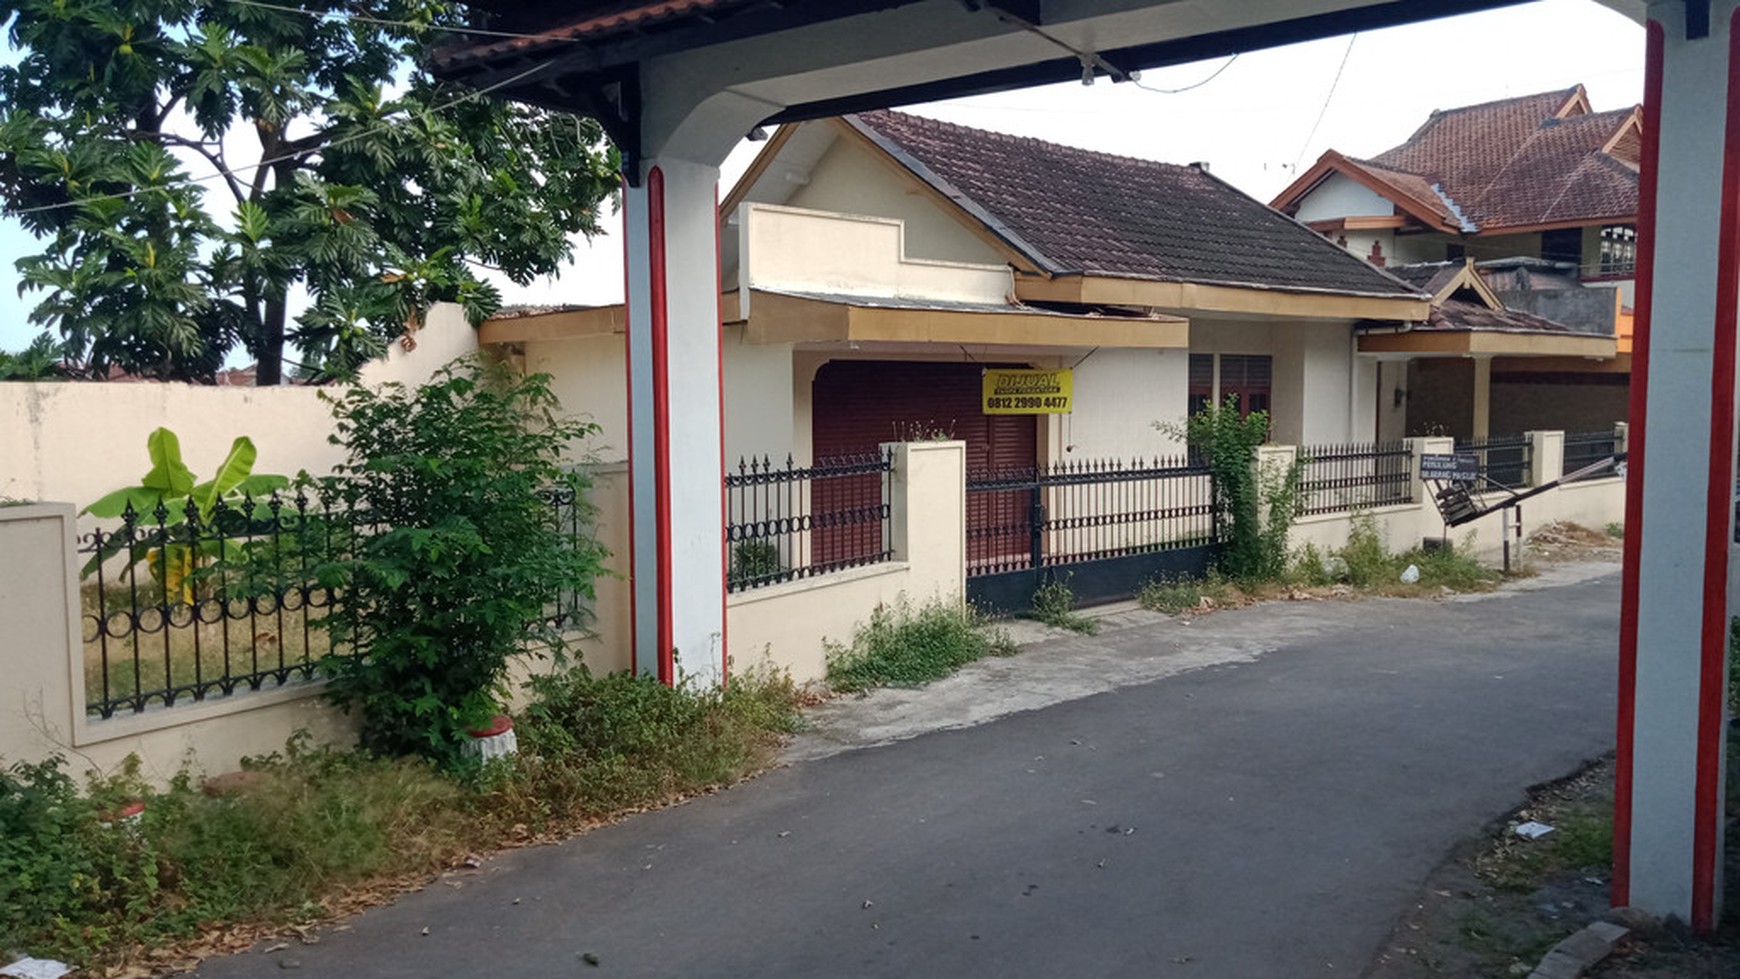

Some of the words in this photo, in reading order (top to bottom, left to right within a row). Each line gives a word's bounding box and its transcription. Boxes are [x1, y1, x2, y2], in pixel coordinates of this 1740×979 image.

[996, 373, 1060, 386] DIJUAL
[988, 397, 1012, 408] 0812
[1044, 397, 1067, 408] 4477
